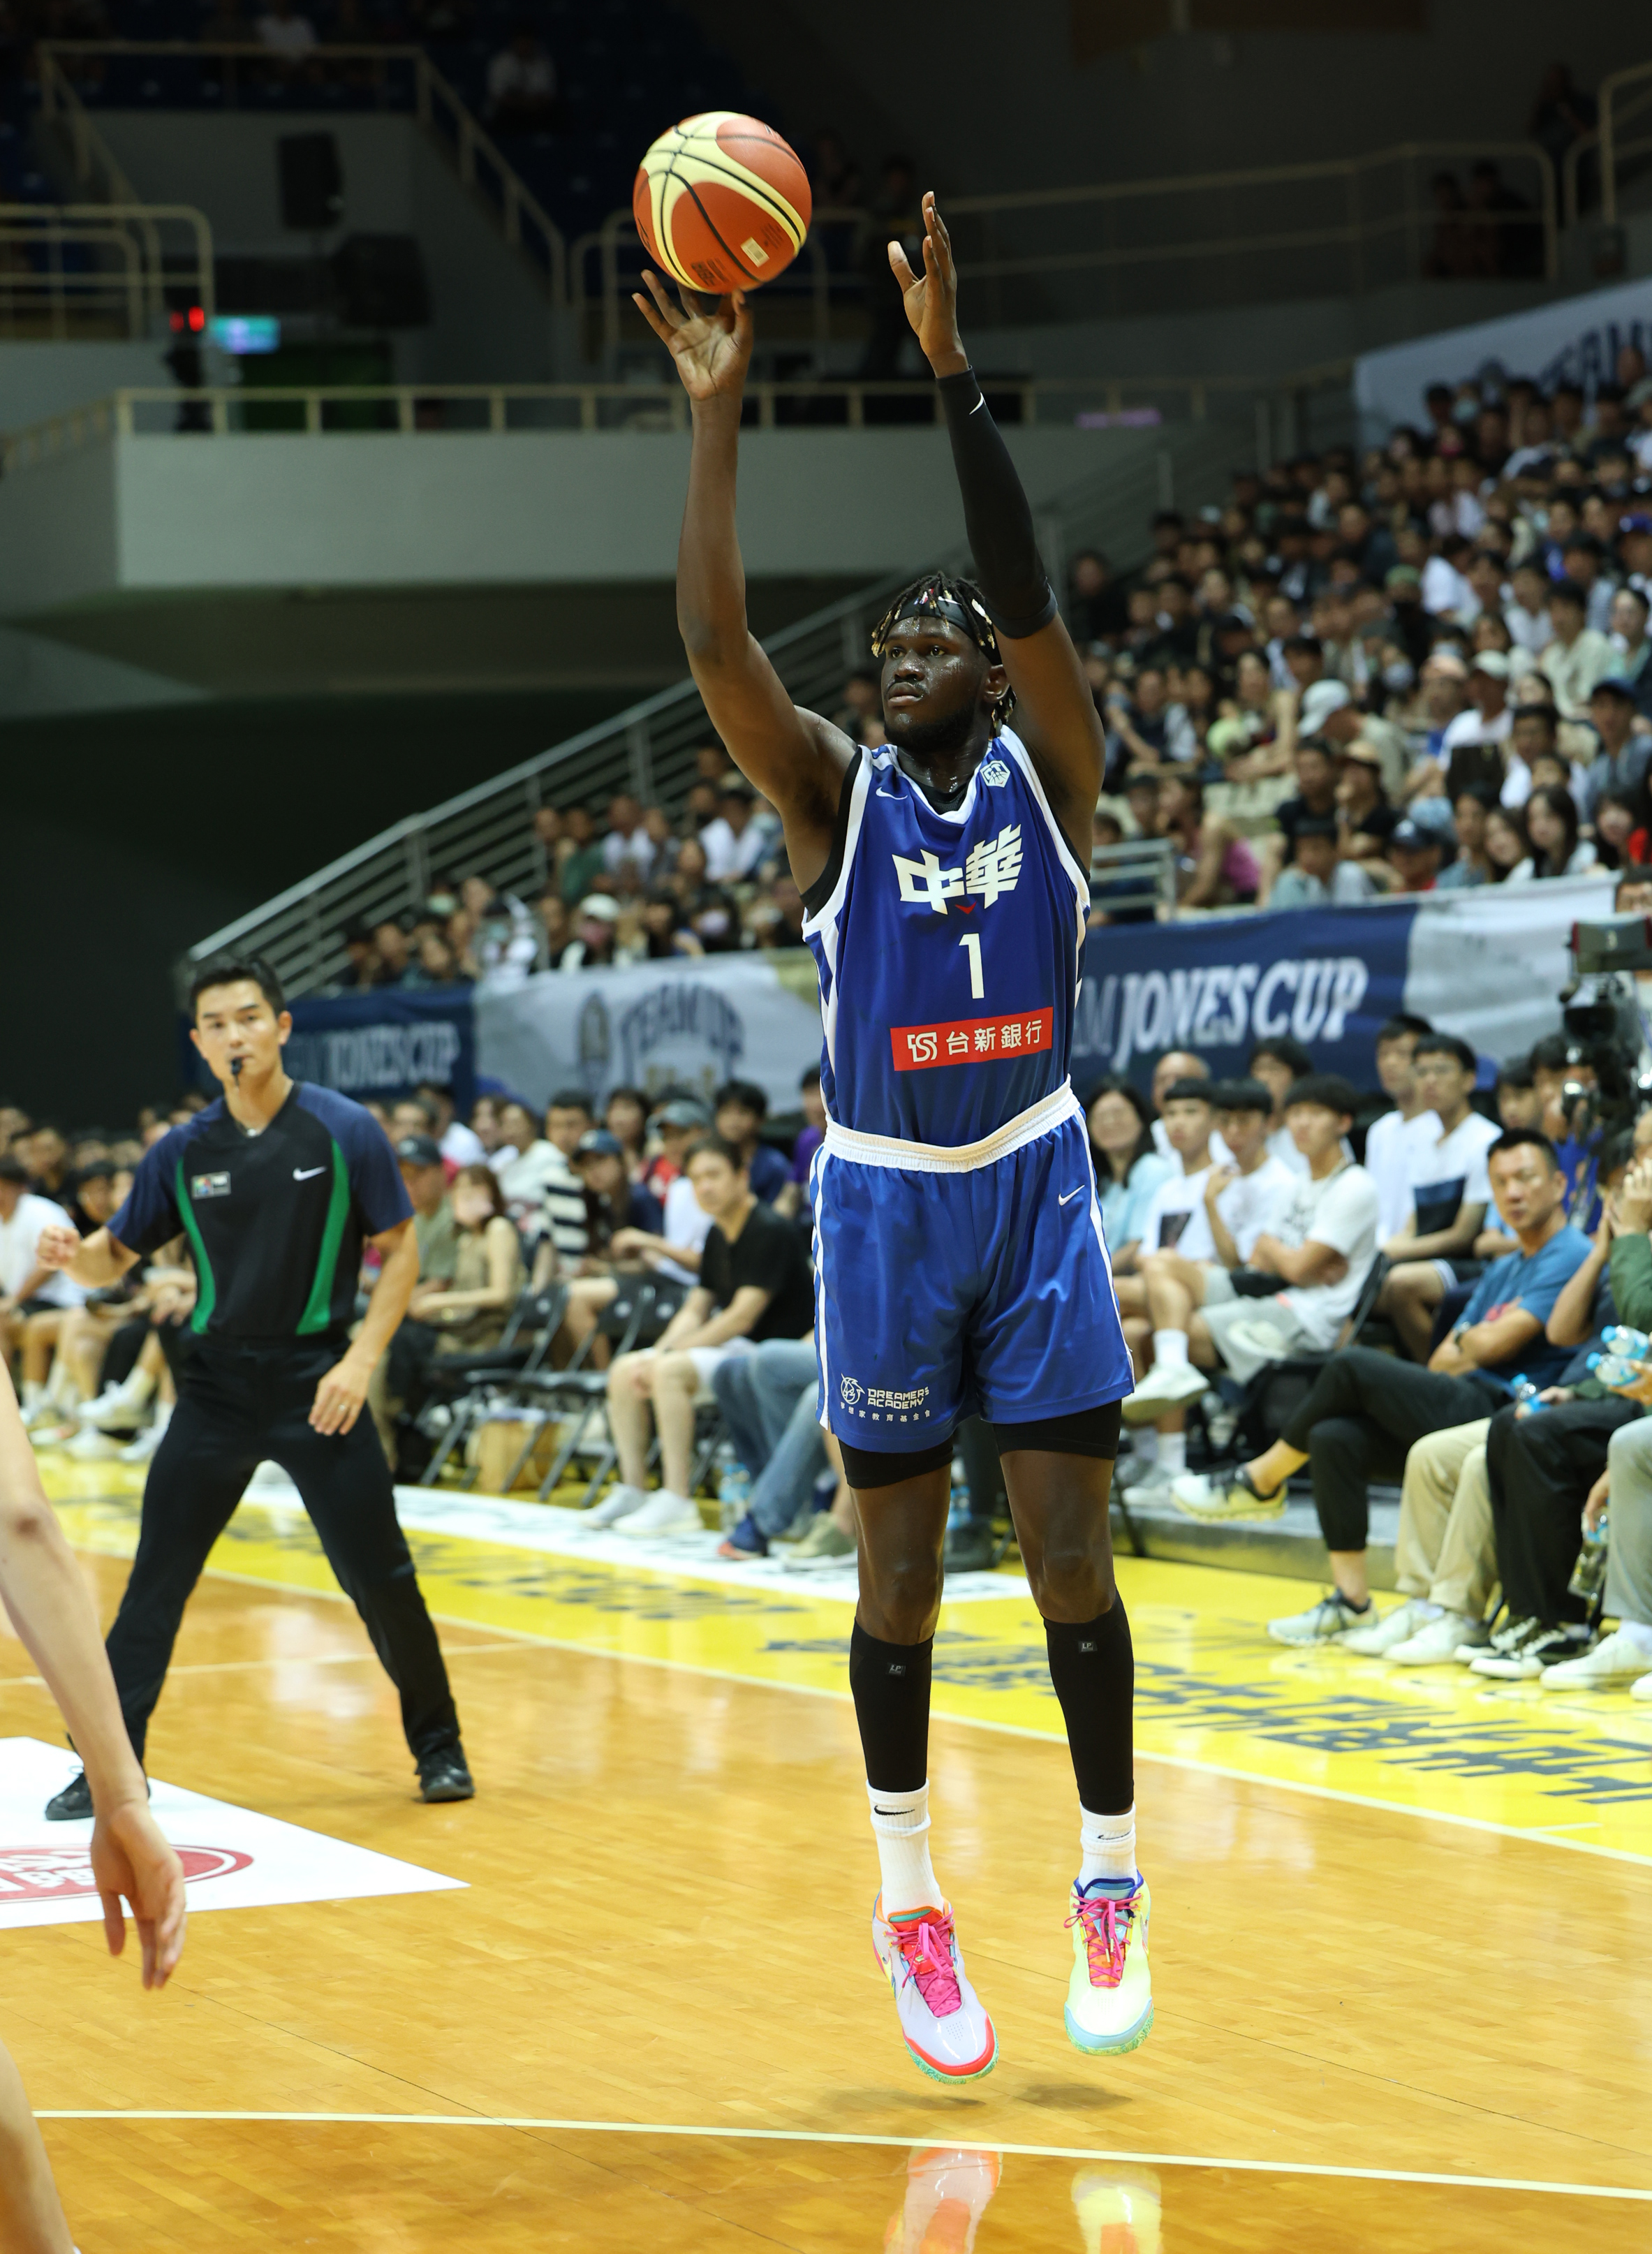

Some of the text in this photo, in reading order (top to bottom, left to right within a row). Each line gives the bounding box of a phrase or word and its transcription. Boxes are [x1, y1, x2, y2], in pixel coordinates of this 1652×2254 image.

[892, 824, 1024, 915] 中華
[959, 933, 984, 999] 1
[946, 1019, 1042, 1055] 台新銀行
[1110, 962, 1260, 1073] JONES
[1252, 955, 1370, 1045] CUP
[867, 1386, 930, 1401] DREAMERS
[867, 1397, 924, 1410] ACADEMY
